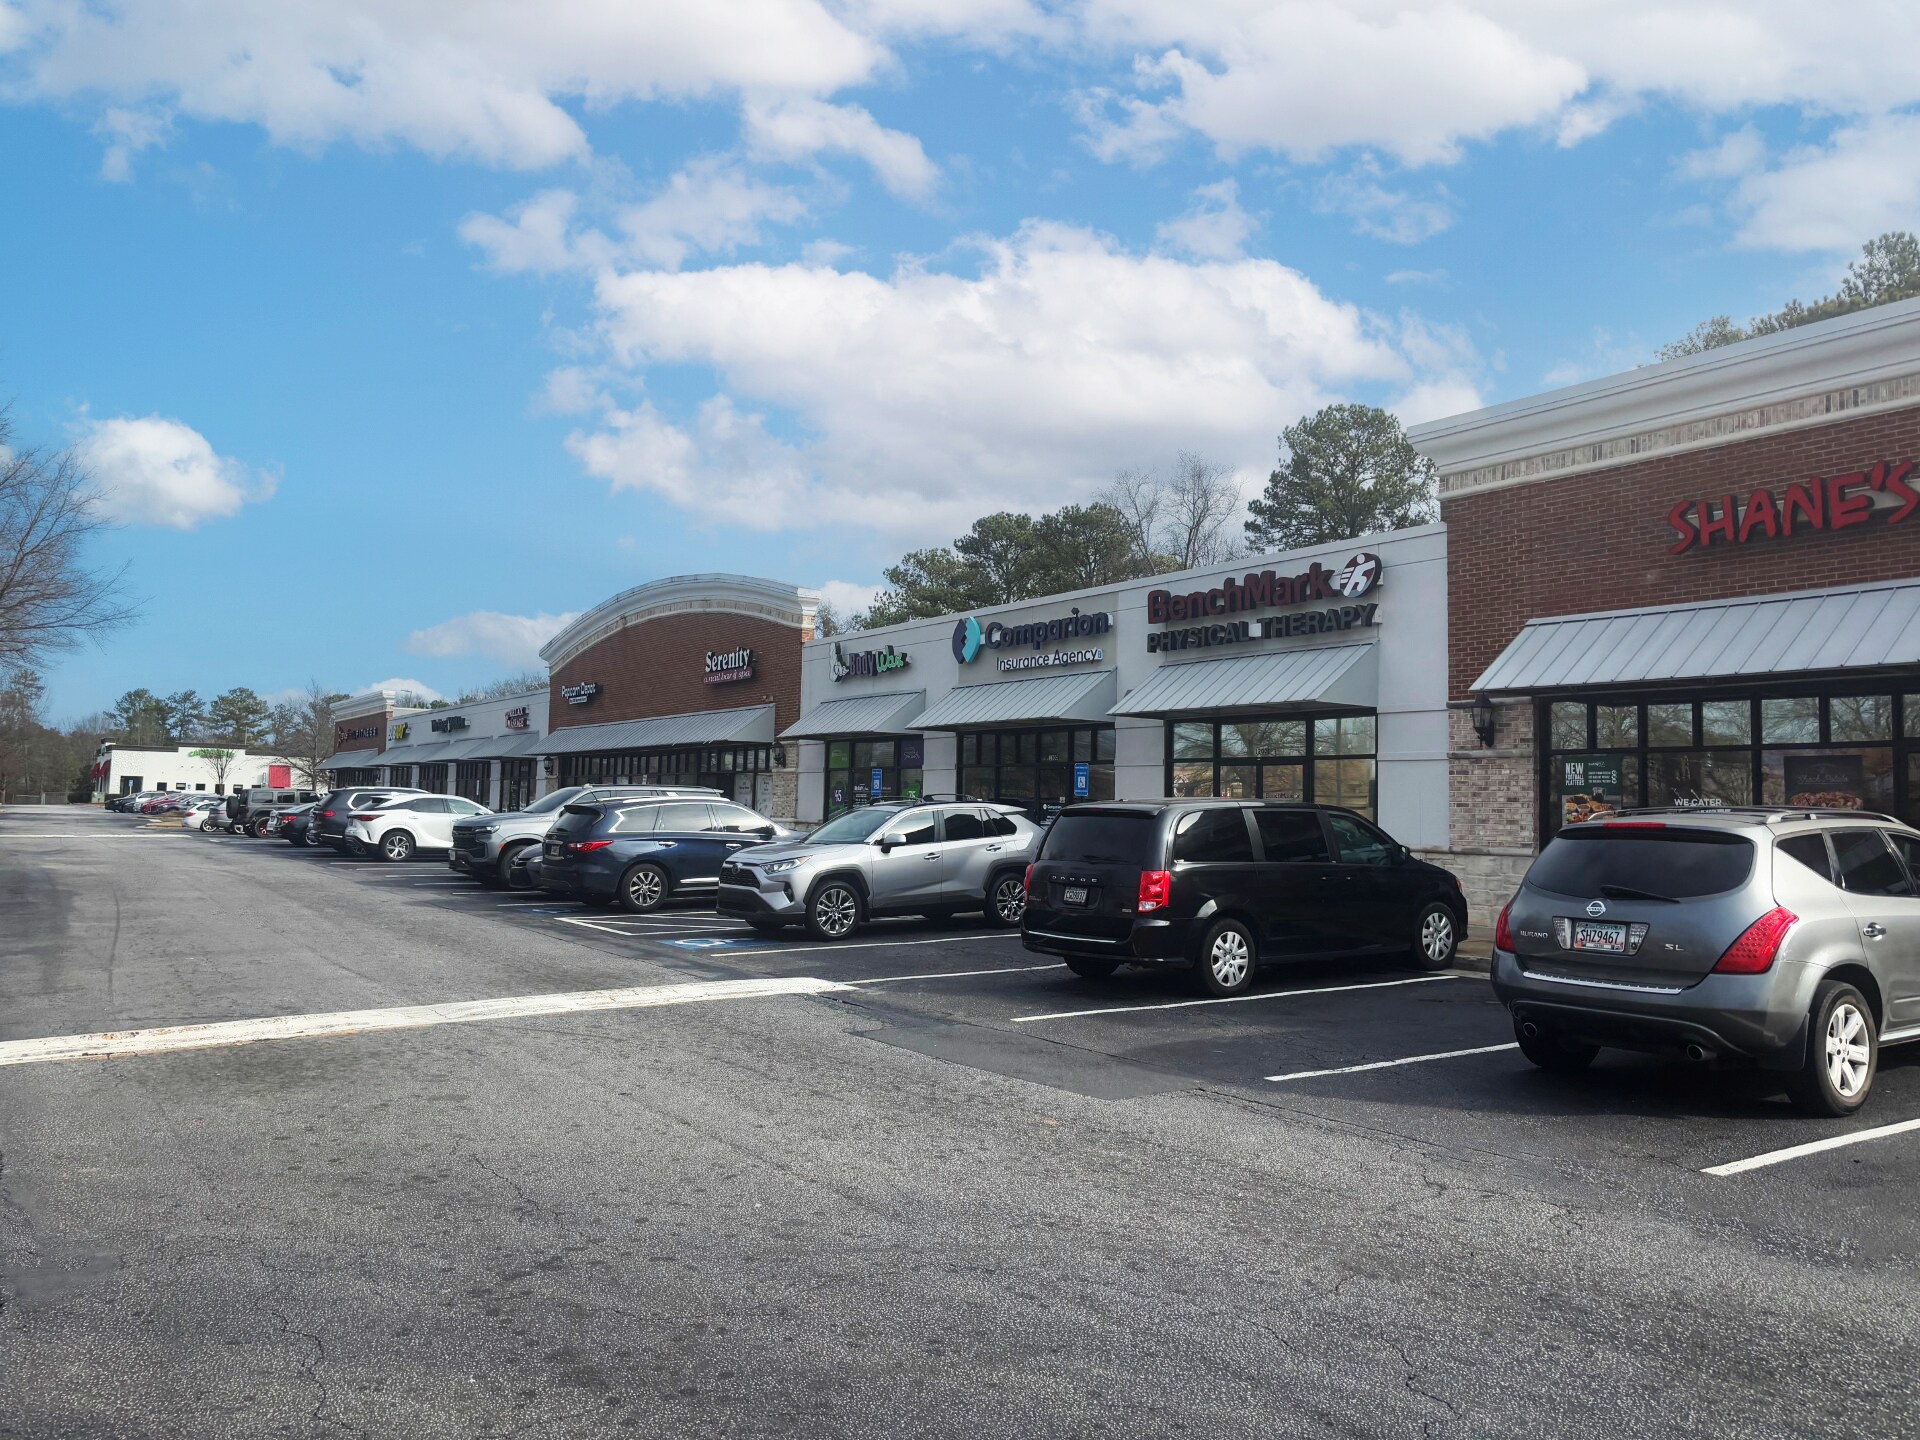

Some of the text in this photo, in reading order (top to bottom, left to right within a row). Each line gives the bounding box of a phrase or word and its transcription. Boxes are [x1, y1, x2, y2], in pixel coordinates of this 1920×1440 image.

[1667, 459, 1920, 555] SHANE'S
[1147, 562, 1337, 624] BenchMark
[985, 607, 1110, 650] Comparion
[1147, 603, 1379, 653] PHYSICAL THERAPY
[705, 646, 750, 673] Serenity
[996, 647, 1098, 672] Insurance Agency
[708, 673, 720, 682] nail
[720, 672, 732, 681] bar
[738, 669, 751, 679] spa
[580, 682, 596, 697] Depot
[1565, 762, 1585, 775] NEW
[1673, 798, 1722, 807] WE CATER
[1580, 929, 1620, 945] SHZ9467
[1664, 943, 1685, 951] SL
